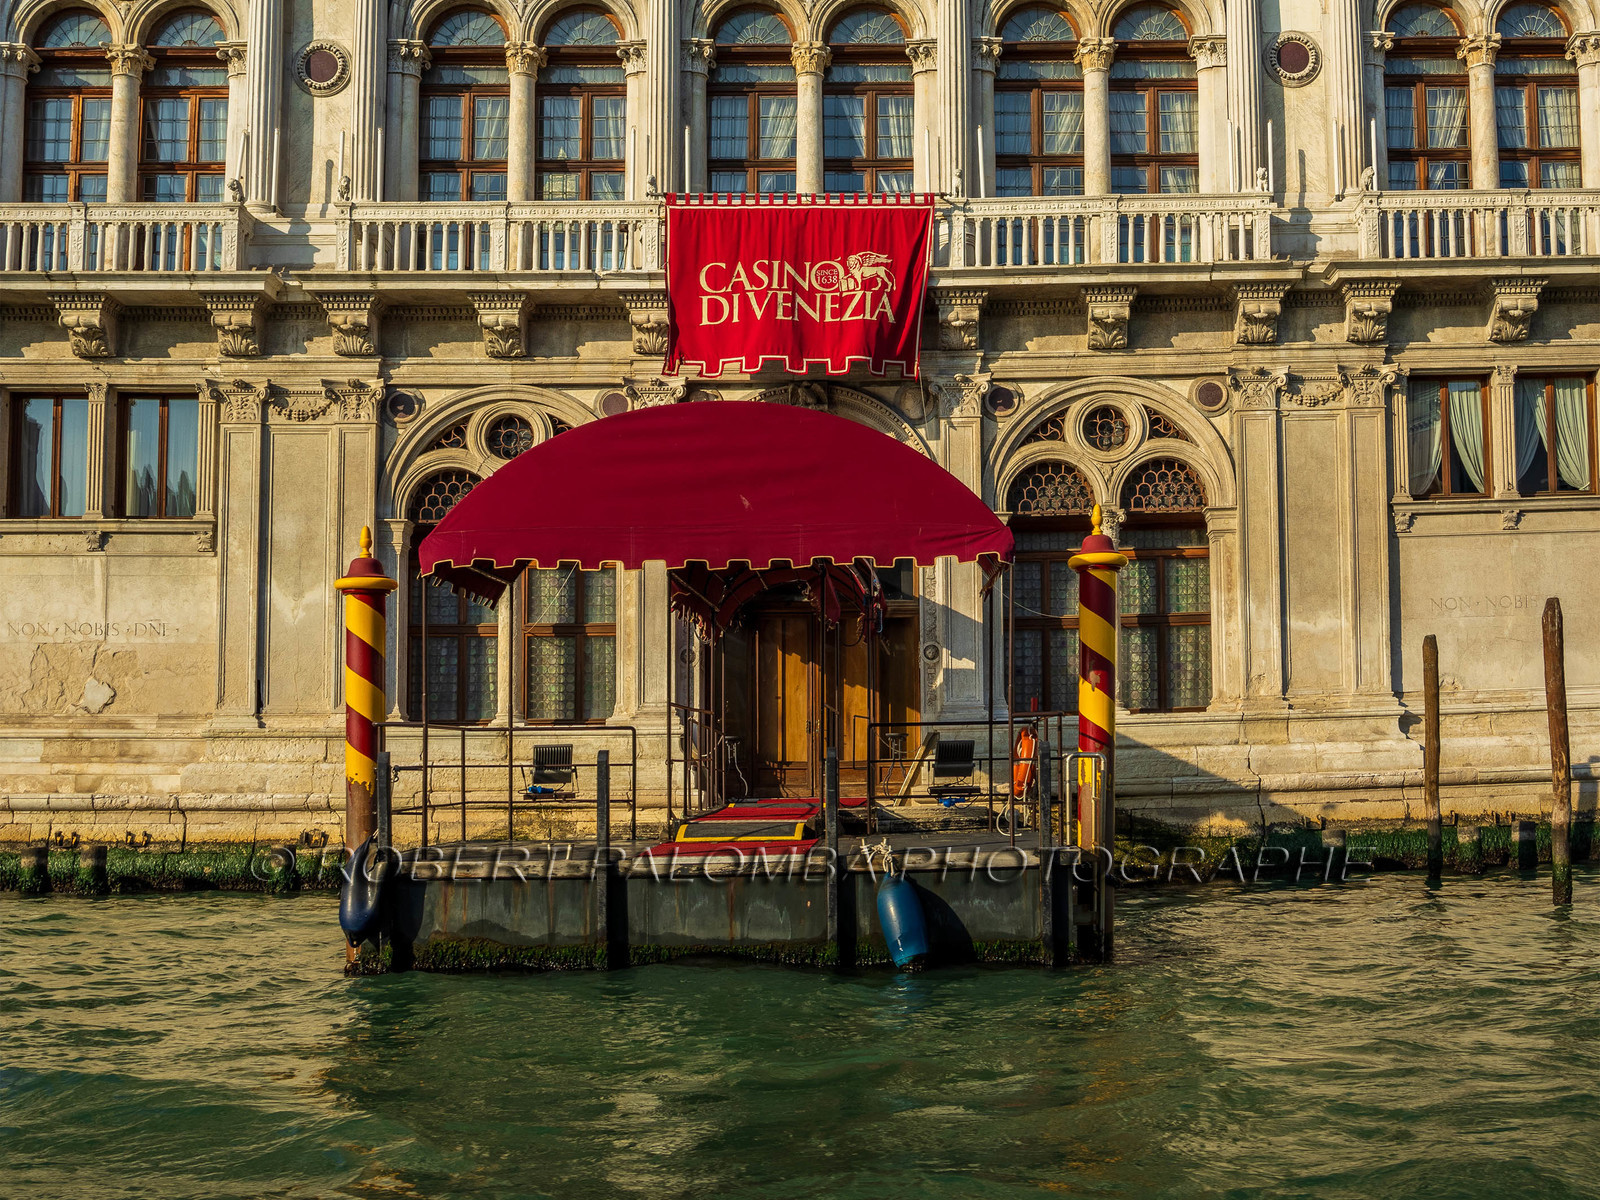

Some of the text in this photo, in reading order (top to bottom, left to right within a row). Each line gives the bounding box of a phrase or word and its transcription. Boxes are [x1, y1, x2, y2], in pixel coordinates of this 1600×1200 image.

[816, 275, 838, 284] 1638
[699, 290, 896, 326] DI VENEZIA
[8, 622, 50, 637] NON
[64, 622, 120, 637] NOBIS
